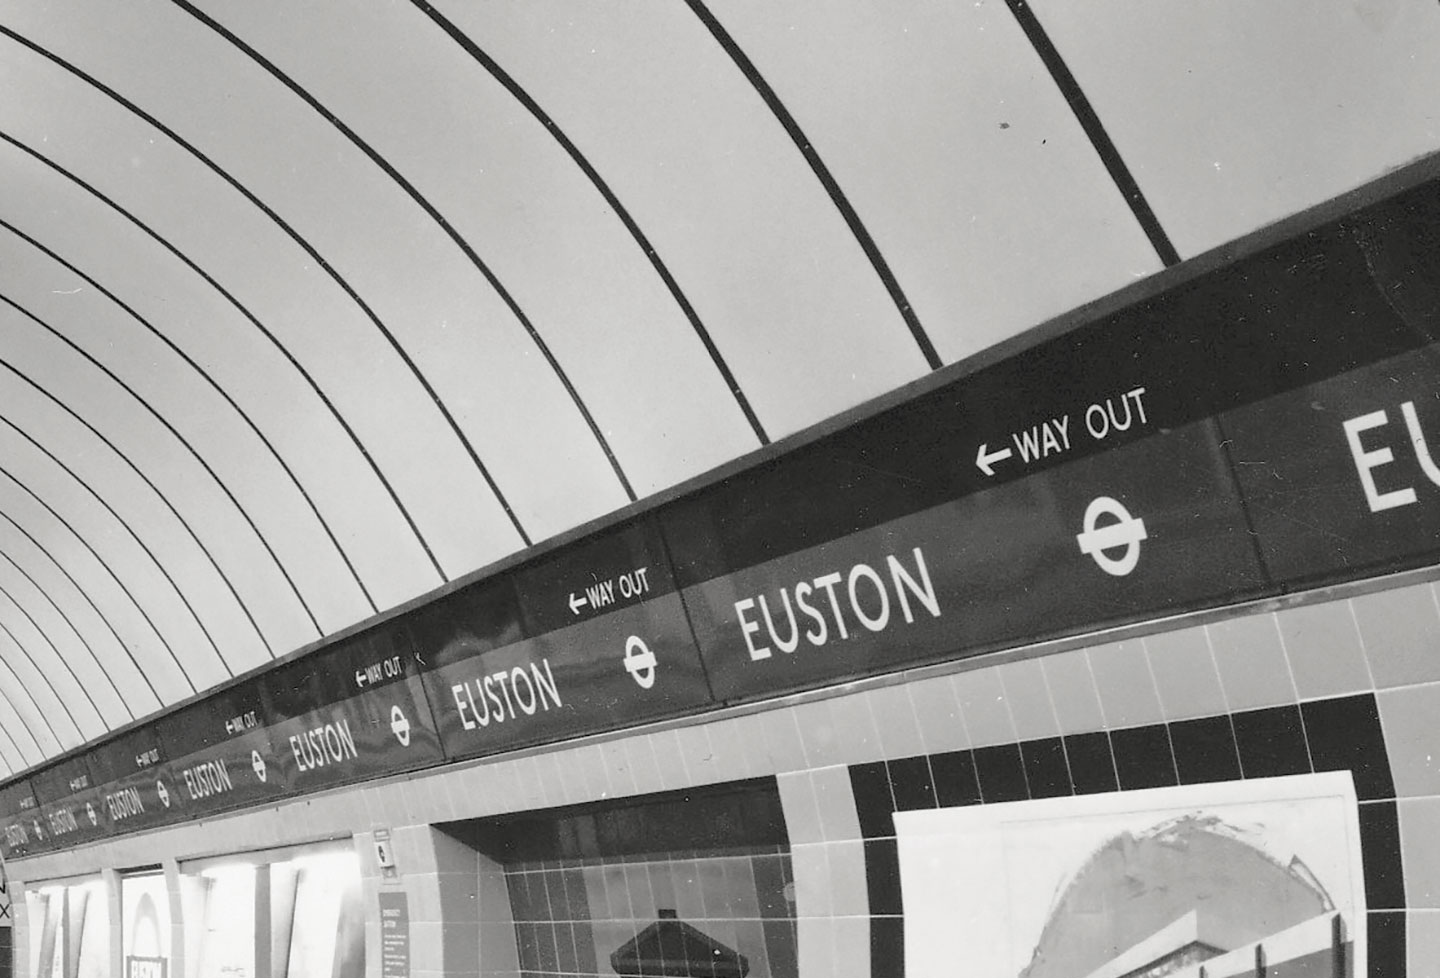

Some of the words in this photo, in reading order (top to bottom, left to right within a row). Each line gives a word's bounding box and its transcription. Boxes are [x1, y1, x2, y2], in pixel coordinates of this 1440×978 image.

[1012, 415, 1072, 464] WAY
[1085, 387, 1148, 440] OUT
[585, 580, 614, 610] WAY
[619, 567, 650, 599] OUT
[734, 547, 941, 662] EUSTON
[364, 662, 383, 685] WAY
[383, 656, 402, 678] OUT
[451, 658, 562, 731] EUSTON
[244, 711, 257, 728] OUT
[289, 719, 358, 771] EUSTON
[183, 758, 233, 800] EUSTON
[107, 786, 145, 821] EUSTON
